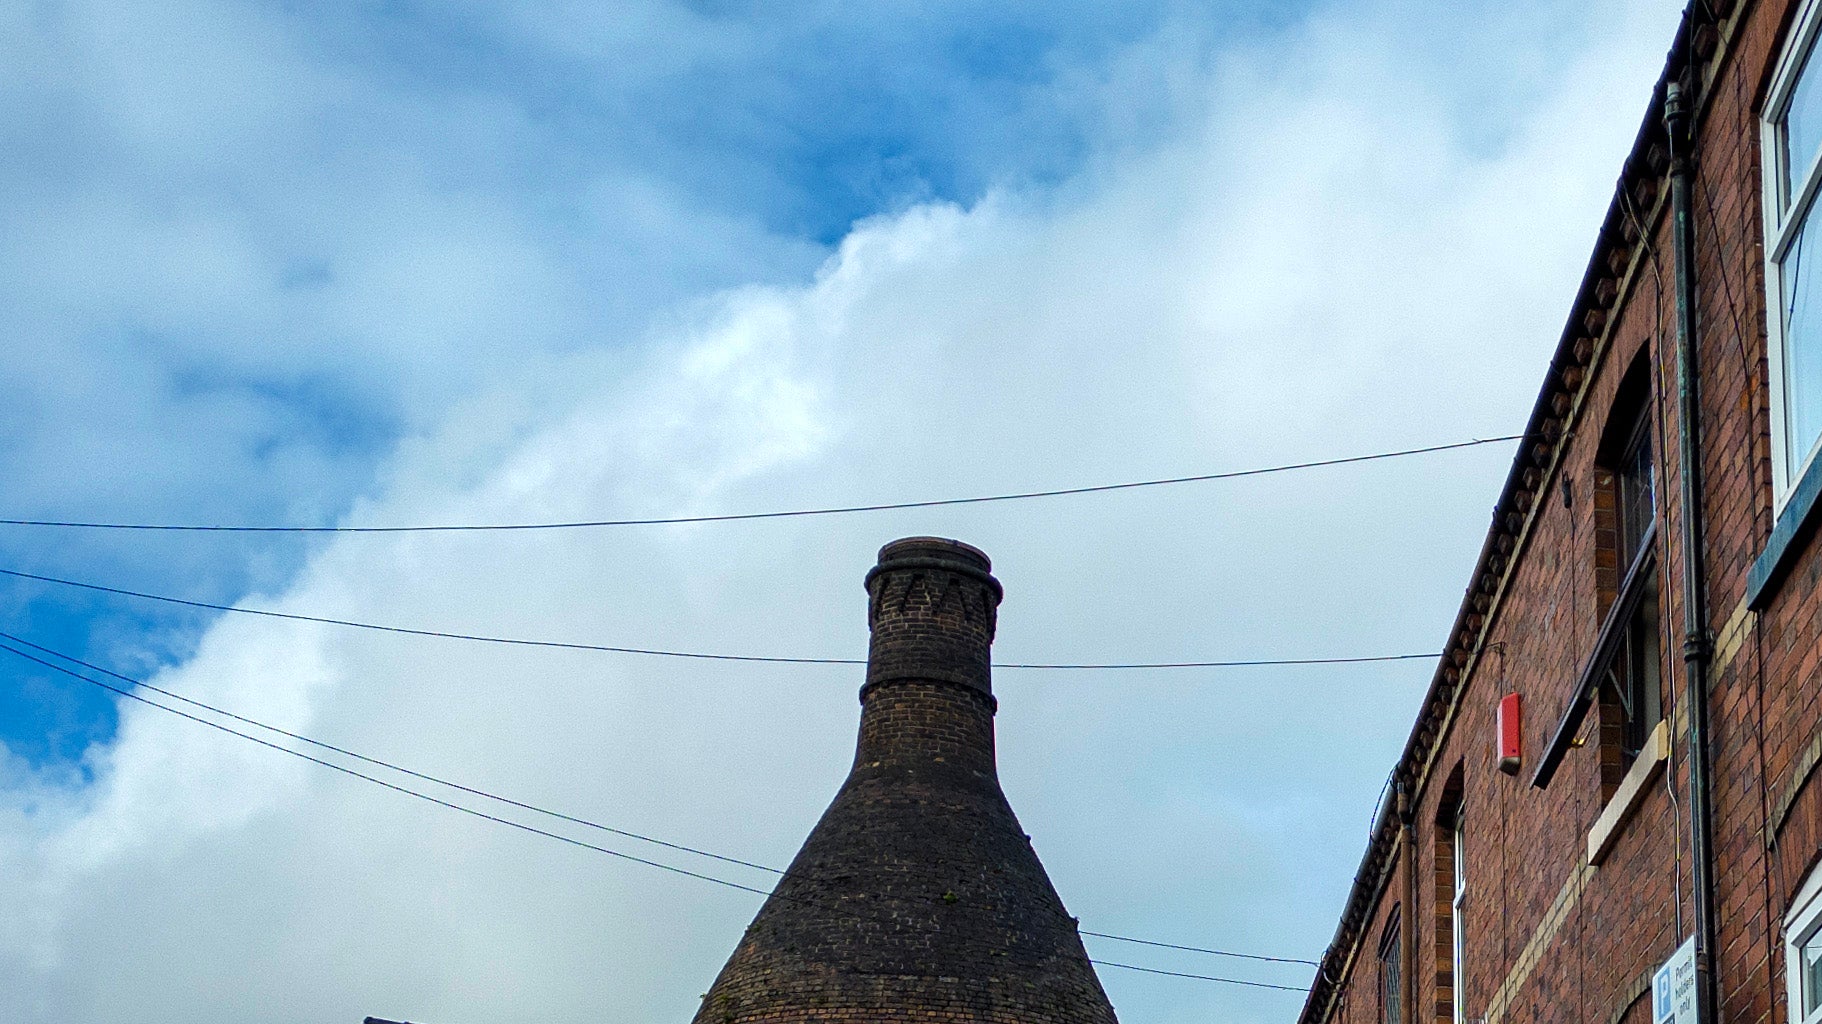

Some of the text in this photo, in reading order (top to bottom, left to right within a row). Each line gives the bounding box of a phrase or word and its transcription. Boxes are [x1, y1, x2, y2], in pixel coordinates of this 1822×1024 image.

[1676, 954, 1693, 980] Permit
[1675, 975, 1694, 1000] holders
[1680, 996, 1690, 1015] only
